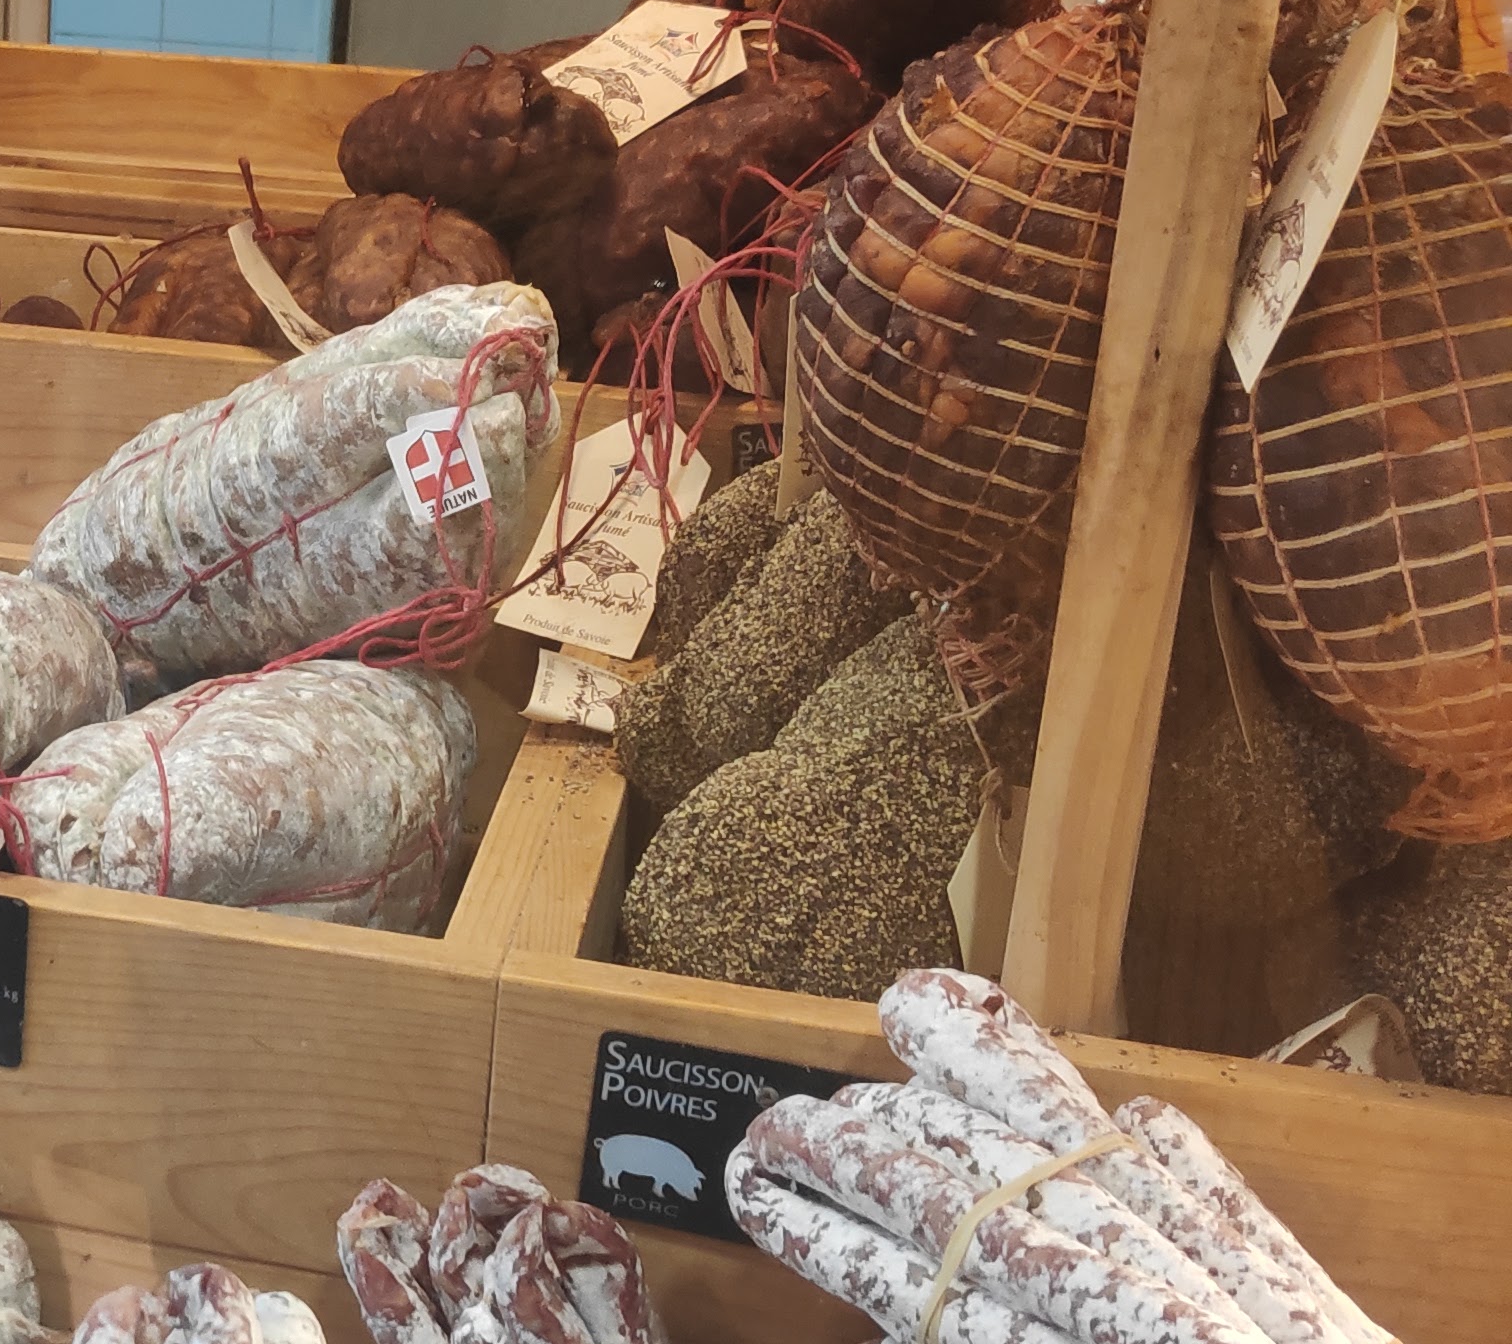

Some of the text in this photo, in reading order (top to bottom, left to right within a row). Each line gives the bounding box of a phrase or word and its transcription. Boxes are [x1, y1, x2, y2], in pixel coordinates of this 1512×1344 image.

[604, 1041, 765, 1097] SAUCISSON
[601, 1072, 718, 1121] POIVRES
[613, 1193, 680, 1218] PORC
